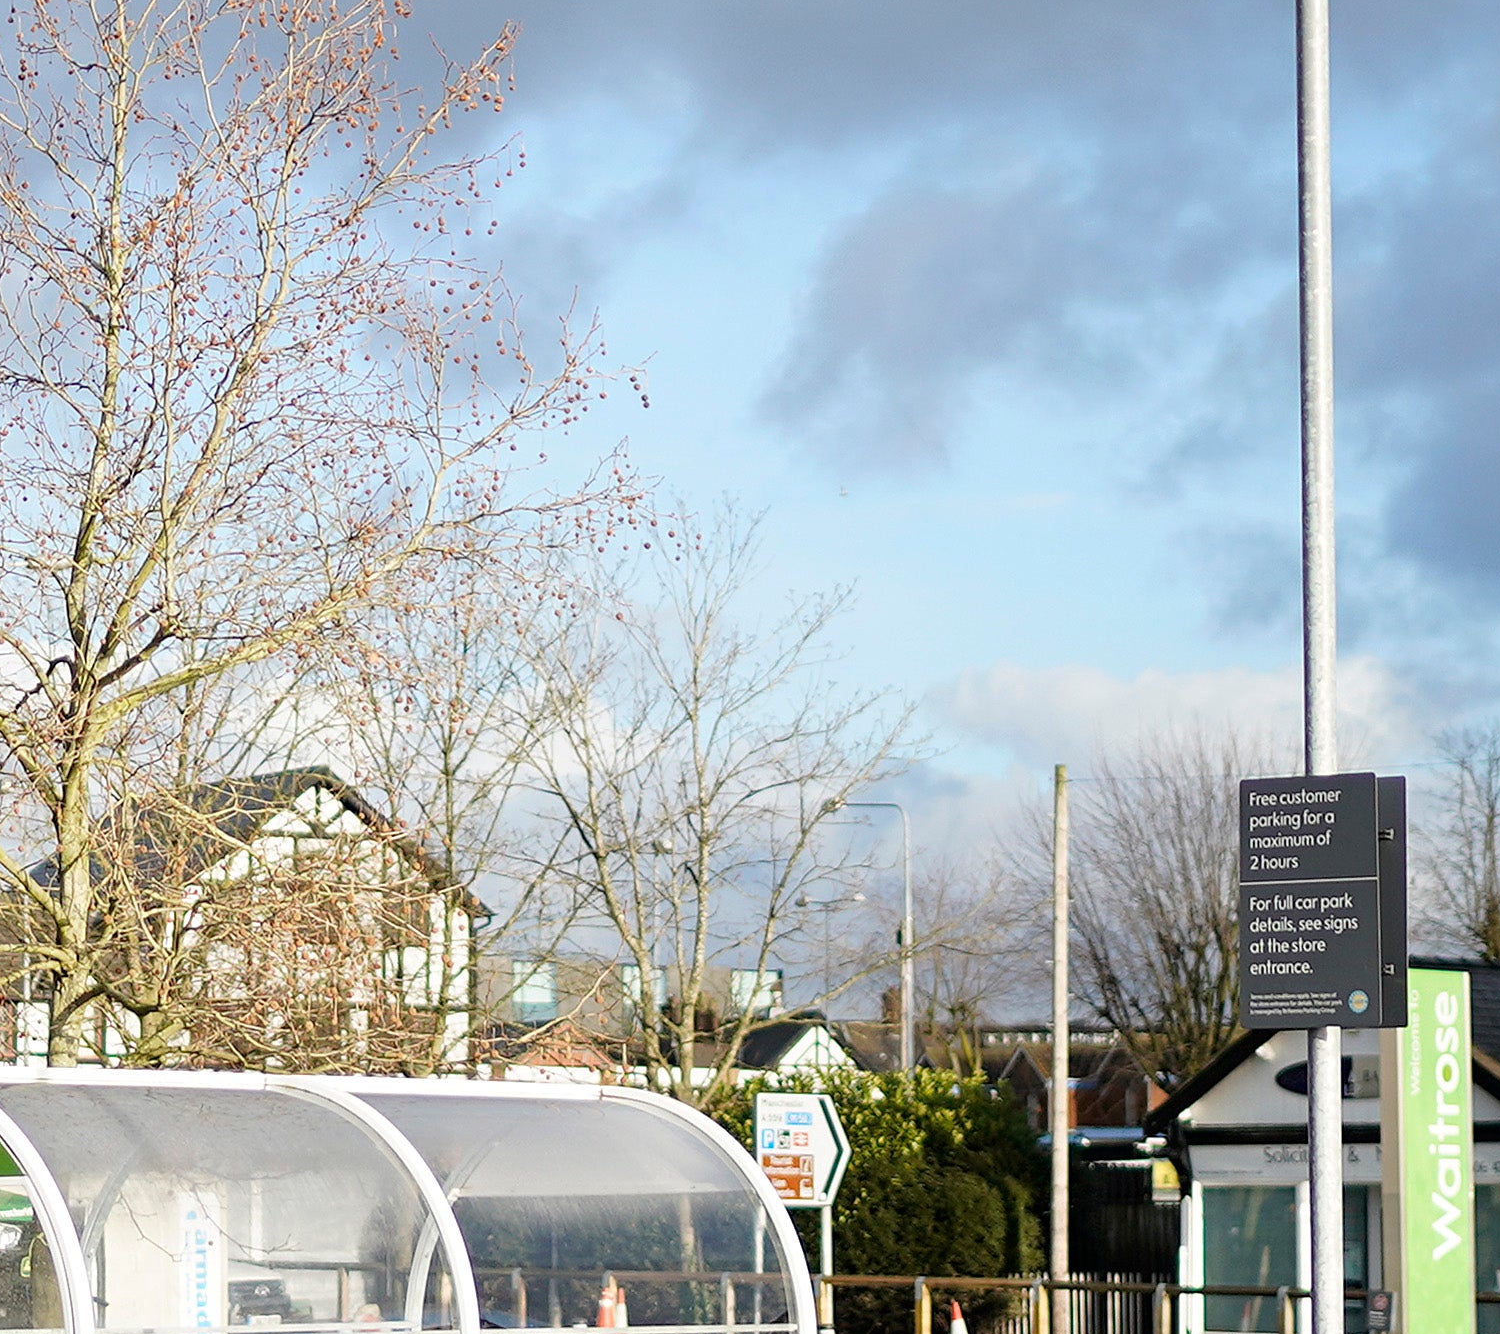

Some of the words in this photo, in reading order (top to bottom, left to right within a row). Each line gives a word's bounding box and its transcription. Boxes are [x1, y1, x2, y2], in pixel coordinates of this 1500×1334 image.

[1249, 792, 1277, 806] Free
[1279, 788, 1341, 805] customer
[1249, 811, 1300, 832] parking
[1303, 809, 1322, 825] for
[1325, 812, 1335, 824] a
[1249, 832, 1315, 849] maximum
[1316, 829, 1332, 845] of
[1250, 855, 1259, 870] 2
[1261, 854, 1299, 870] hours
[1249, 896, 1271, 912] For
[1274, 894, 1293, 911] full
[1295, 897, 1319, 910] car
[1320, 892, 1353, 913] park
[1249, 916, 1297, 933] details,
[1298, 918, 1322, 931] see
[1324, 914, 1359, 935] signs
[1249, 938, 1264, 954] at
[1267, 937, 1290, 953] the
[1291, 937, 1327, 953] store
[1249, 959, 1314, 975] entrance.
[1408, 989, 1419, 1009] to
[1410, 1012, 1421, 1096] Welcome
[1428, 990, 1463, 1261] Waitrose
